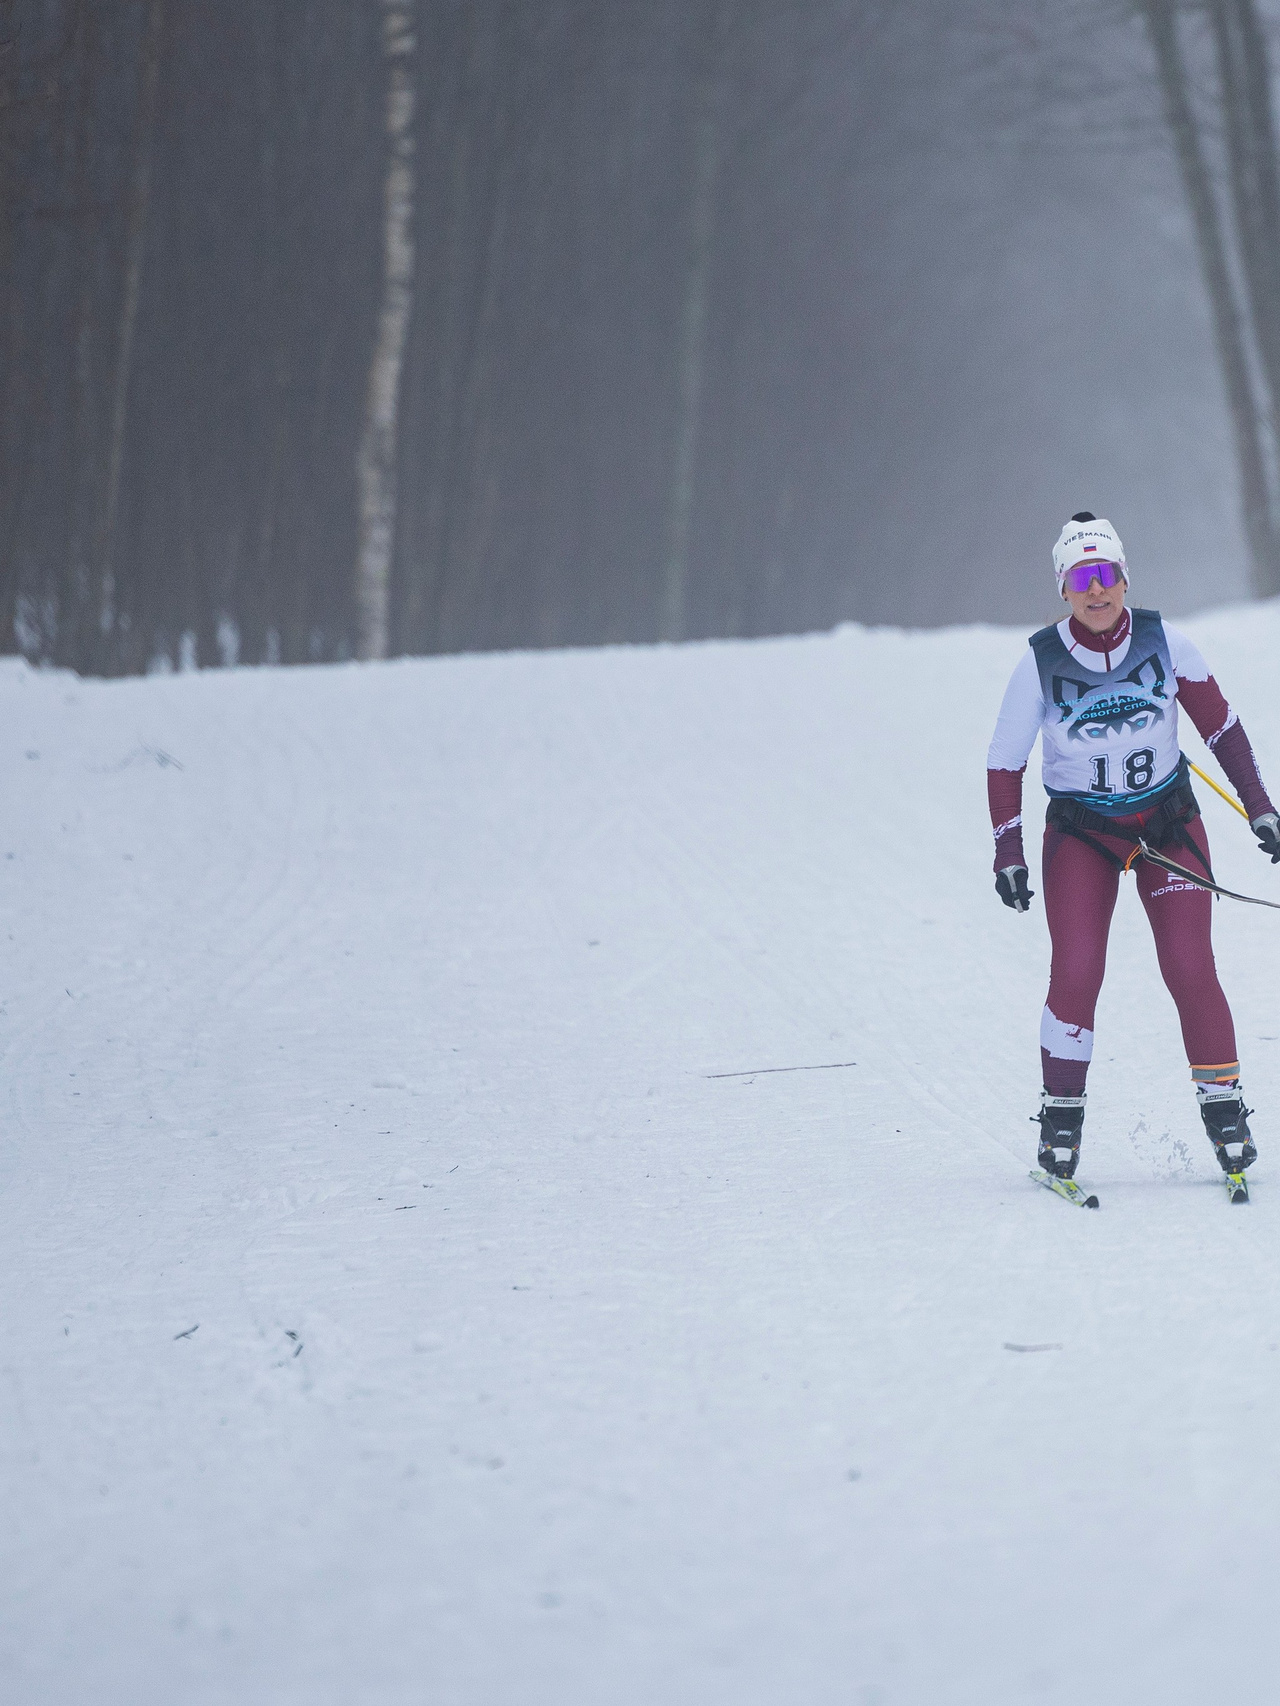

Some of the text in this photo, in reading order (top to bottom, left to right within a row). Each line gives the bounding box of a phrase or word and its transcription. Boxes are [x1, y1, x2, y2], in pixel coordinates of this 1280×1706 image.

[1062, 695, 1167, 721] ДОВОГО СПОРА
[1072, 690, 1154, 711] ДЕРАЦ
[1088, 746, 1156, 795] 18
